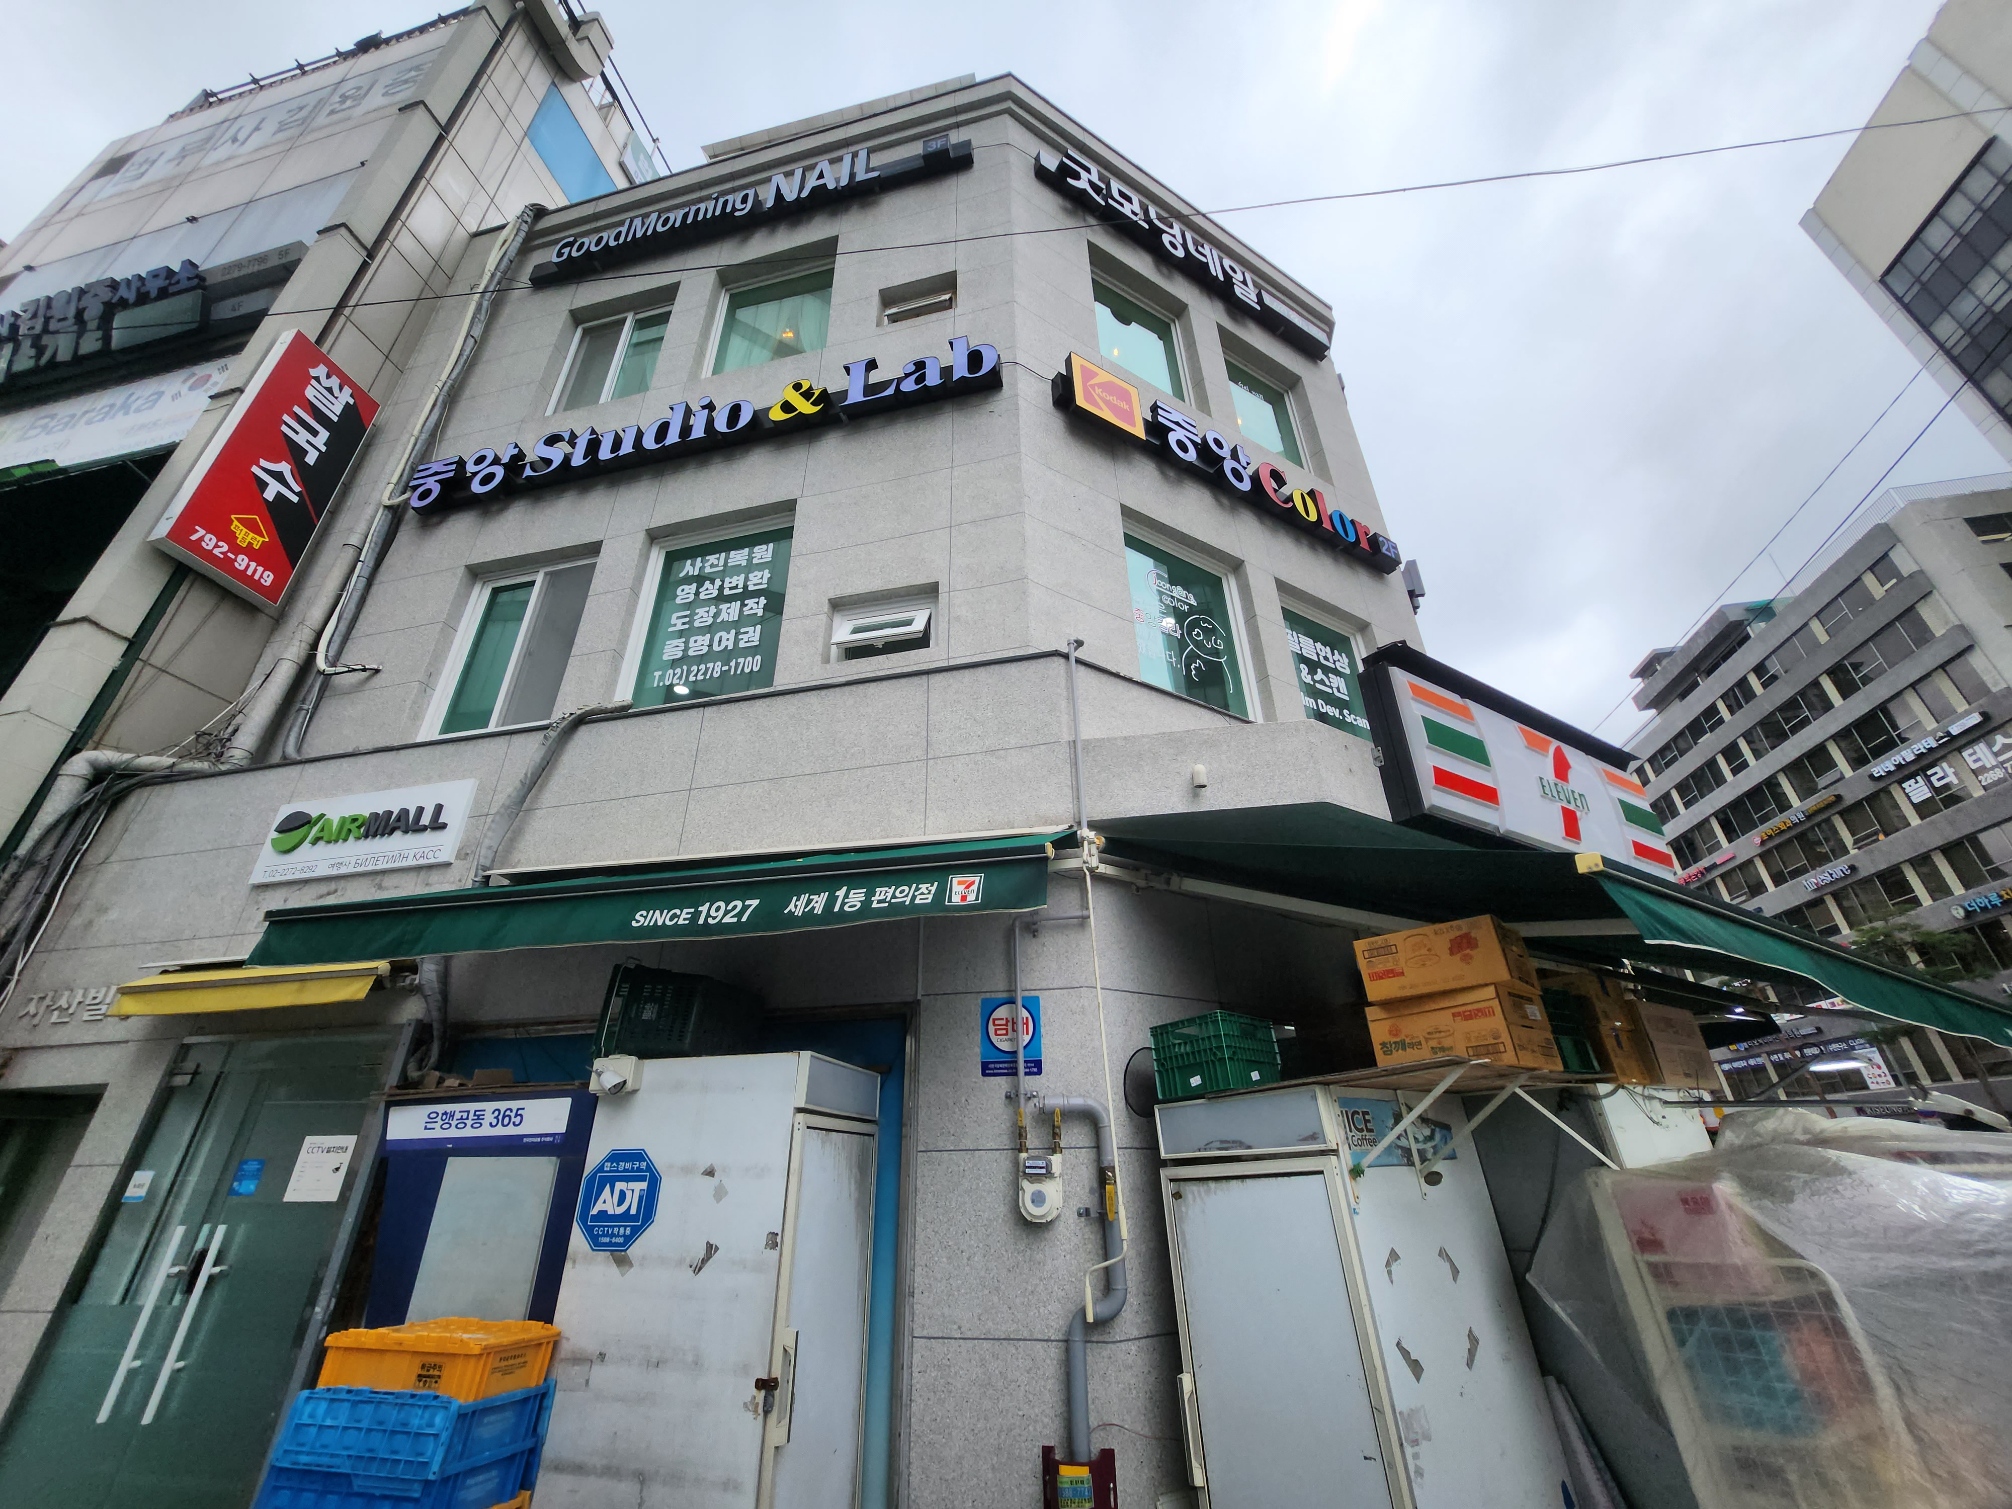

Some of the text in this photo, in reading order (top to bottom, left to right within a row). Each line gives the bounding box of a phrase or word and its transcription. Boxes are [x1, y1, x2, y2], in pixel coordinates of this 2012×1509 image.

[551, 137, 947, 264] GoodMorning NAIL 3F
[1062, 148, 1261, 311] 굿모닝네일
[18, 389, 166, 443] Baraka
[522, 396, 755, 479] Studio
[767, 378, 827, 423] &
[838, 335, 1000, 408] Lab
[1094, 384, 1131, 413] Kodak
[251, 363, 355, 504] 쌀국수
[1153, 402, 1399, 559] 중앙 Color 2F
[189, 526, 275, 587] 792-9119
[679, 543, 774, 578] 사진복원
[675, 569, 771, 605] 영상변환
[667, 596, 767, 632] 도장제작
[662, 624, 762, 661] 증명여권
[1299, 663, 1350, 701] & 스캔
[1317, 698, 1343, 720] Dev.
[308, 802, 448, 846] AIRMALL
[412, 848, 442, 862] КАСС
[631, 881, 939, 927] SINCE 1927 세계 1등 편의점
[18, 985, 118, 1027] 자산빌
[991, 1016, 1030, 1037] 담배
[423, 1106, 526, 1131] 은행공동 365
[1344, 1109, 1376, 1134] ICE
[1350, 1134, 1379, 1148] Coffee
[590, 1181, 648, 1215] ADT
